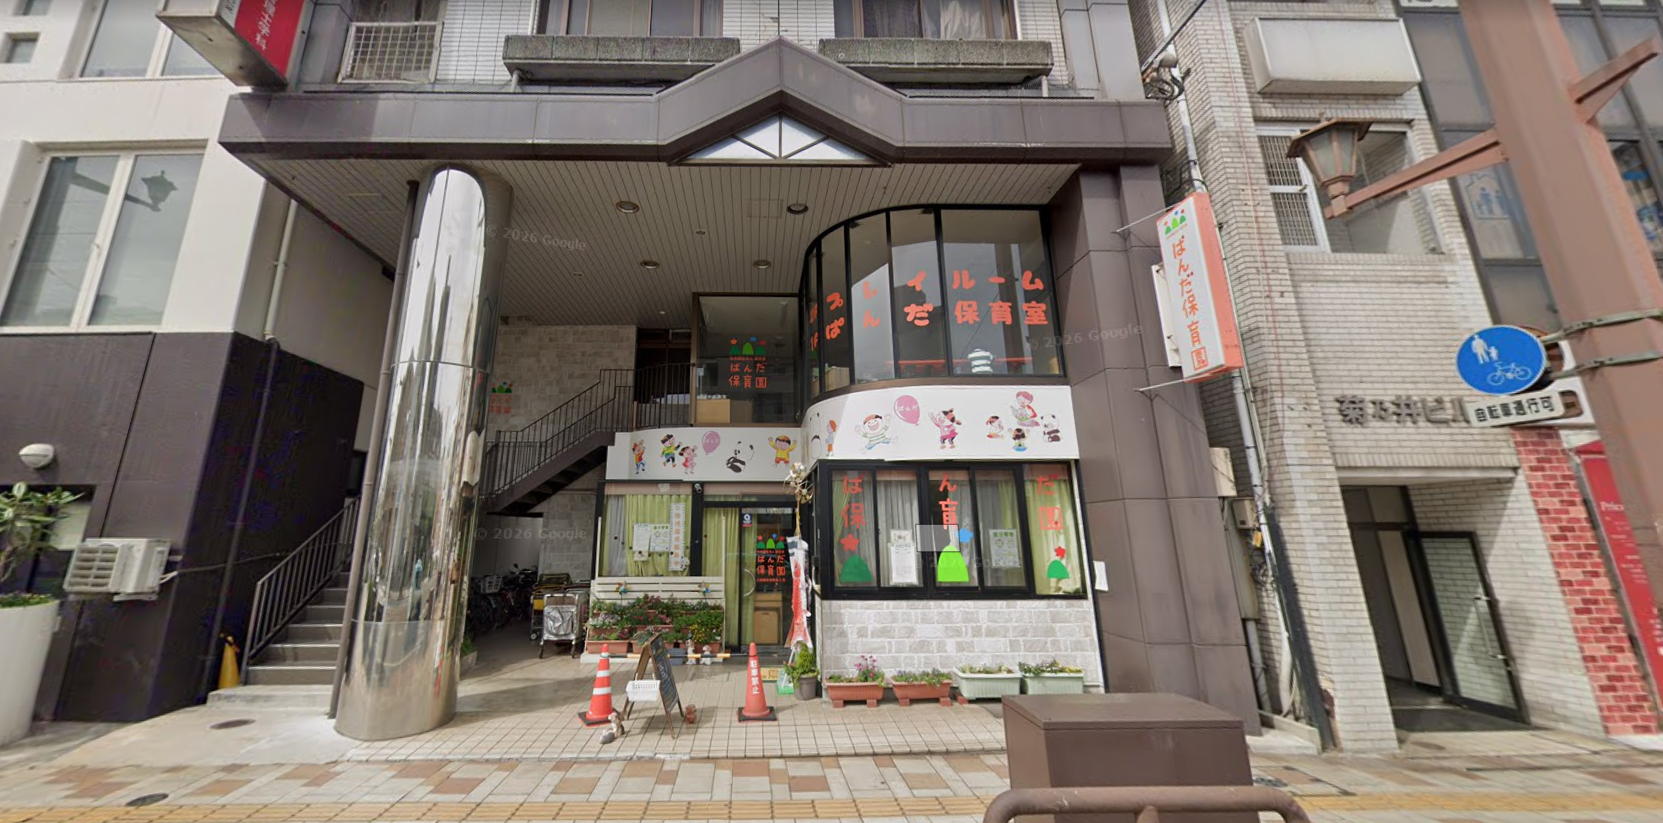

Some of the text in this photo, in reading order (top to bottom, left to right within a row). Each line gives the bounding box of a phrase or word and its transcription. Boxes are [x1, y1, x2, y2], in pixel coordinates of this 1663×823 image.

[825, 300, 1049, 340] ぱんだ保育室
[728, 374, 767, 389] 保育園
[1474, 395, 1555, 422] 自転車通行可
